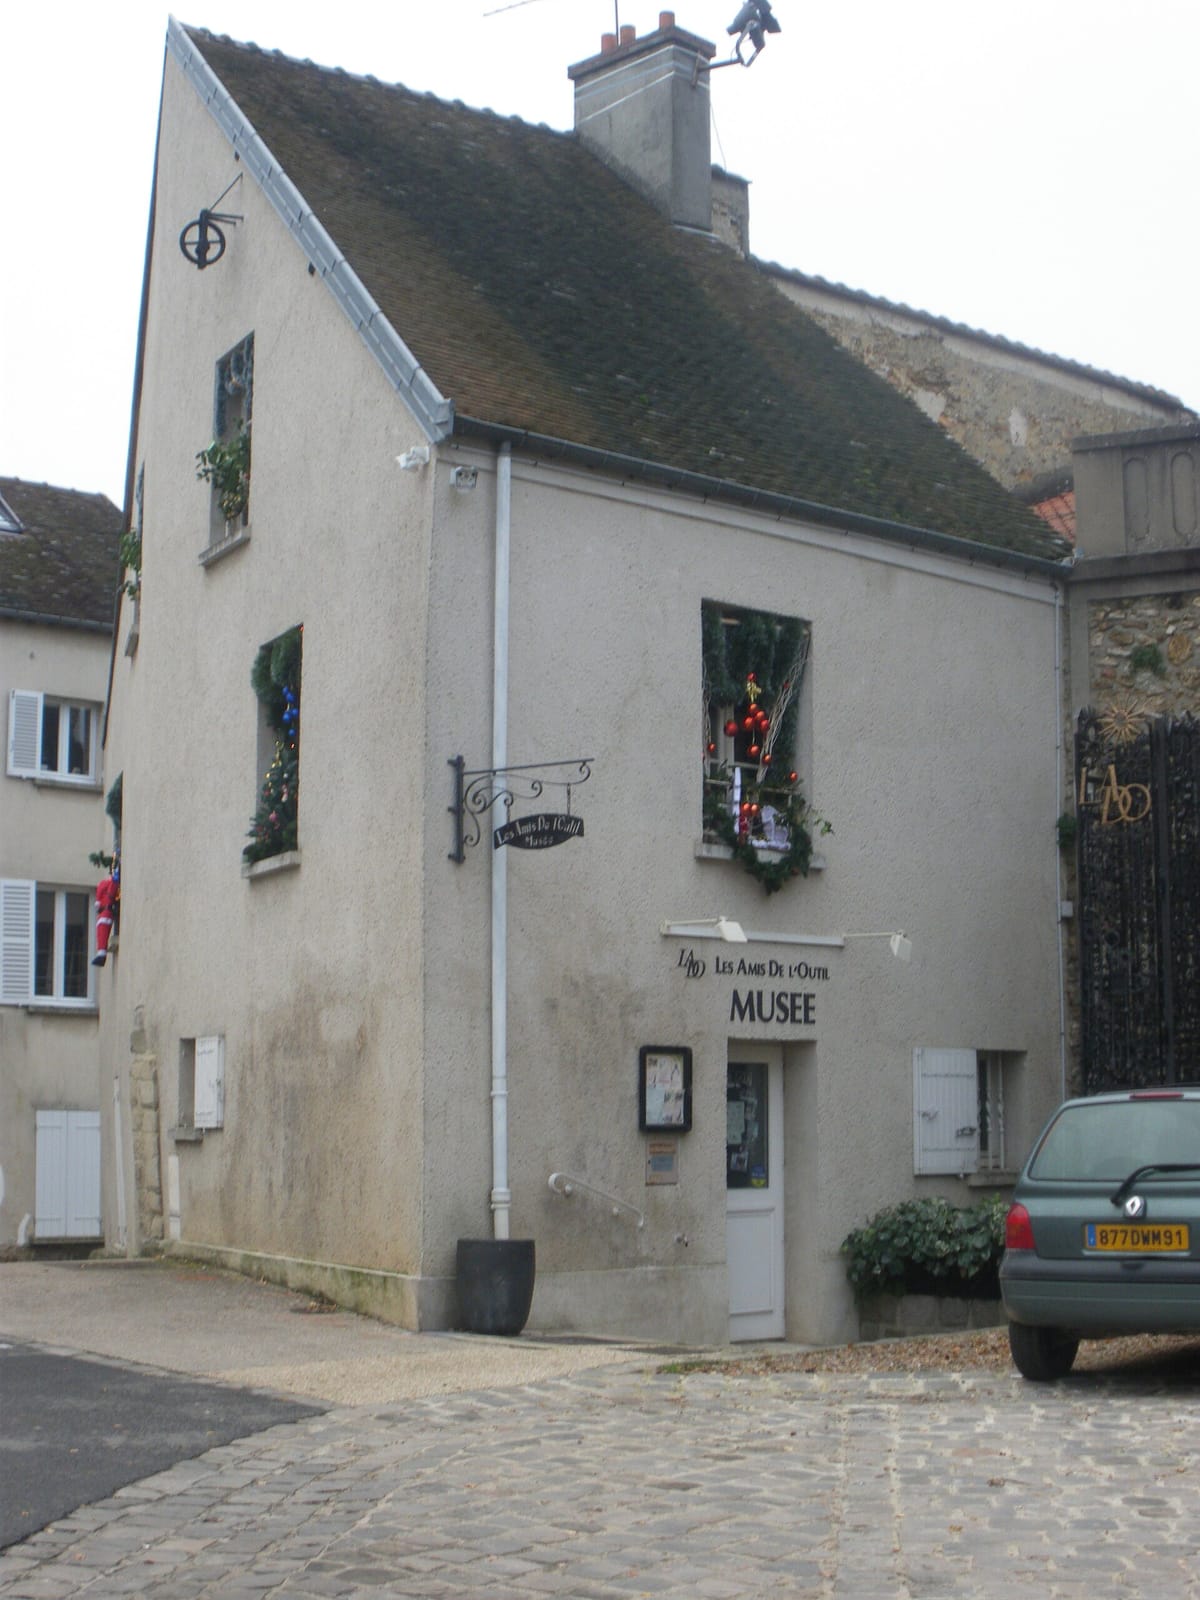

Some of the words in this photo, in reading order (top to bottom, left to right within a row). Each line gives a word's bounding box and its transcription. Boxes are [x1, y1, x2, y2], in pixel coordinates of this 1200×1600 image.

[715, 955, 733, 975] LES
[736, 958, 766, 977] AMIS
[769, 959, 784, 977] DE
[730, 989, 816, 1025] MUSEE
